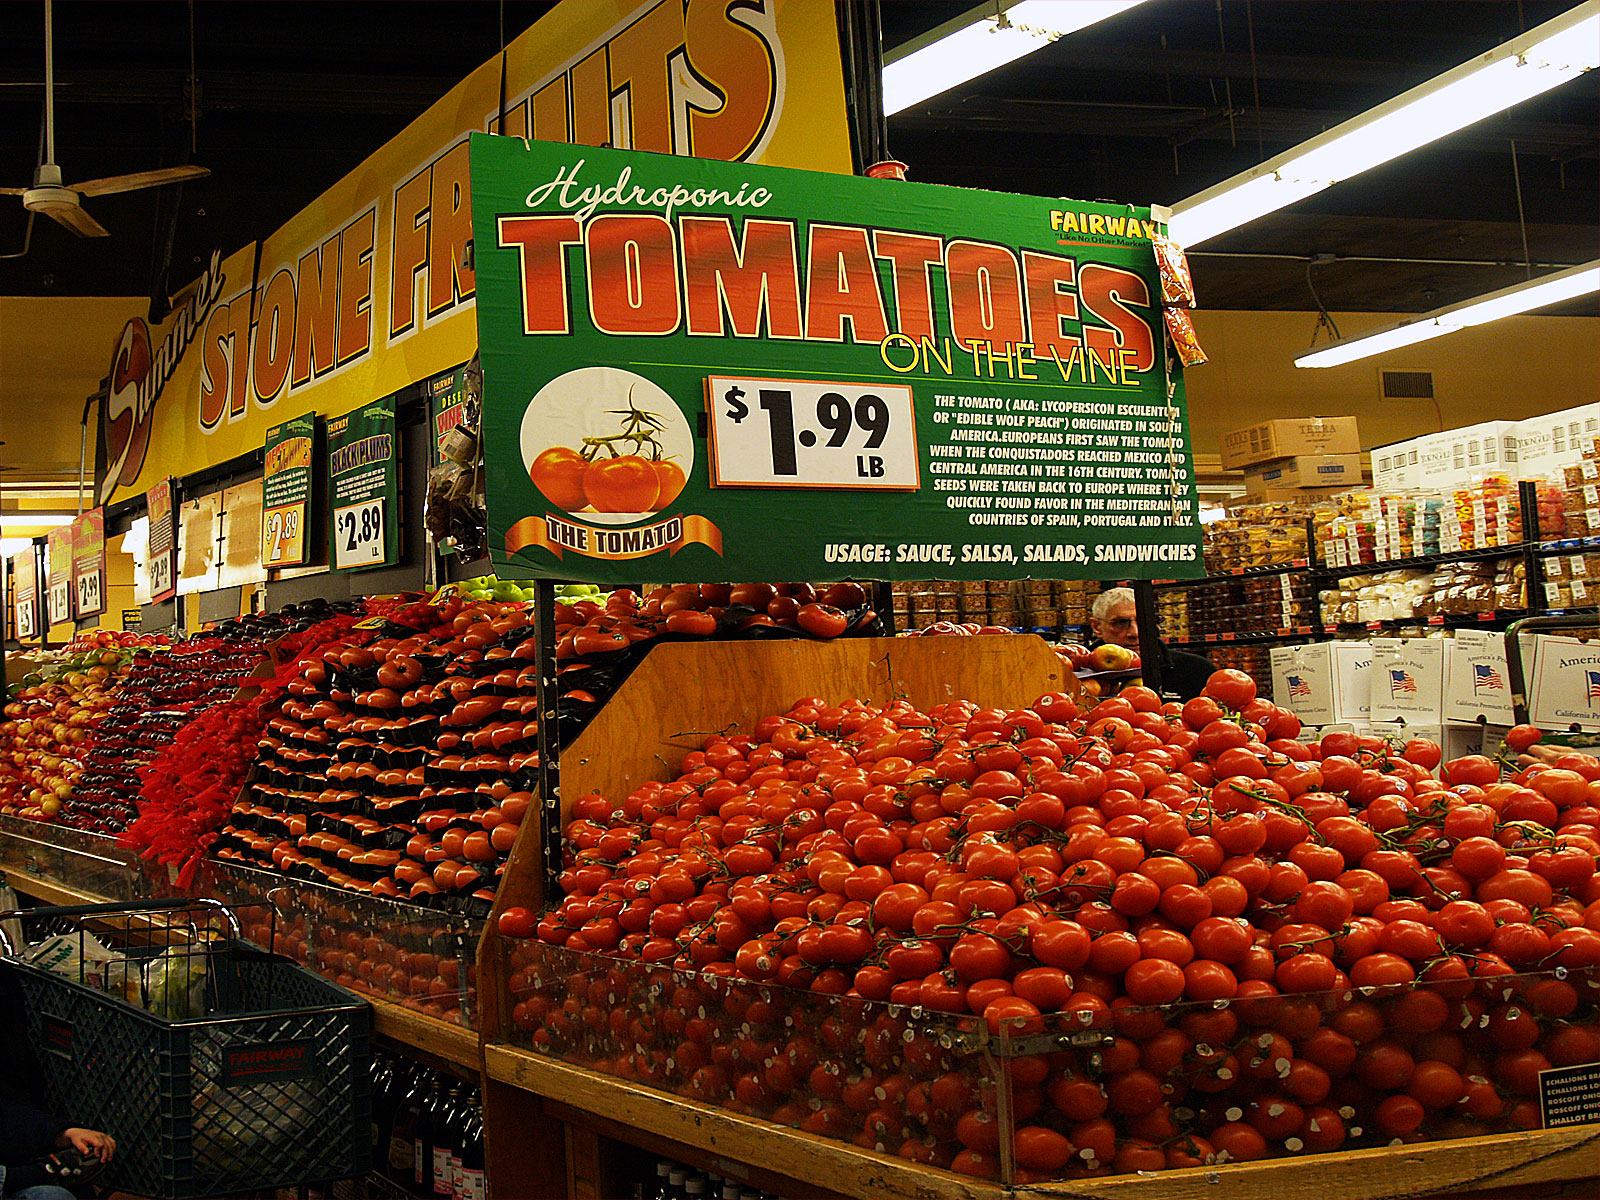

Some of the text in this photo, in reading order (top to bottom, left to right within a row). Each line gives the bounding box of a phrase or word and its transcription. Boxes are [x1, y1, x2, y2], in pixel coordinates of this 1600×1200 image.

[525, 159, 773, 224] Hydroponic
[1050, 210, 1155, 240] FAIRWAY
[1091, 236, 1115, 244] Other
[497, 212, 1156, 373] TOMATOES
[199, 200, 379, 434] STONE
[880, 333, 1141, 386] ON THE VINE
[934, 395, 955, 407] THE
[958, 396, 1003, 409] TOMATO
[1041, 400, 1115, 415] LYCOPERSICON
[724, 385, 890, 477] $1.99
[933, 411, 949, 424] OR
[951, 412, 994, 426] "EDIBLE
[996, 414, 1026, 427] WOLF
[1027, 416, 1069, 431] PEACH")
[1071, 417, 1133, 431] ORIGINATED
[1135, 420, 1147, 432] IN
[1065, 433, 1094, 446] FIRST
[1095, 435, 1120, 447] SAW
[1121, 436, 1140, 448] THE
[1142, 437, 1184, 449] TOMATO
[330, 433, 392, 478] BLACK PLUMS
[930, 445, 1185, 465] WHEN THE CONQUISTADORS REACHED MEXICO AND
[856, 455, 885, 478] LB
[929, 462, 978, 475] CENTRAL
[980, 463, 1028, 476] AMERICA
[1030, 465, 1043, 477] IN
[1045, 465, 1066, 477] THE
[1068, 466, 1094, 478] 16TH
[1096, 467, 1144, 479] CENTURY.
[934, 479, 967, 491] SEEDS
[969, 480, 999, 492] WERE
[1002, 481, 1036, 493] TAKEN
[1038, 482, 1066, 493] BACK
[1069, 482, 1082, 494] TO
[1084, 483, 1125, 495] EUROPE
[1127, 484, 1162, 495] WHERE
[946, 496, 993, 509] QUICKLY
[995, 497, 1032, 509] FOUND
[1034, 498, 1068, 510] FAVOR
[1070, 499, 1083, 510] IN
[1085, 499, 1104, 510] THE
[338, 505, 381, 551] $2.89
[968, 514, 1029, 526] COUNTRIES
[1030, 514, 1045, 526] OF
[1046, 515, 1081, 528] SPAIN,
[1083, 515, 1137, 526] PORTUGAL
[1139, 516, 1161, 527] AND
[266, 509, 299, 562] $2.89
[546, 515, 684, 555] THE TOMATO
[824, 543, 1197, 565] USAGE: SAUCE, SALSA, SALADS, SANDWICHES
[79, 575, 98, 607] $2.99
[1555, 709, 1590, 719] California
[229, 1045, 307, 1065] FAIRWAY
[1546, 1074, 1587, 1086] ECHALIONS
[1547, 1084, 1588, 1095] ECHALIONS
[1548, 1095, 1580, 1106] ROSCOFF
[1549, 1105, 1581, 1115] ROSCOFF
[1549, 1114, 1586, 1126] SHALLOT
